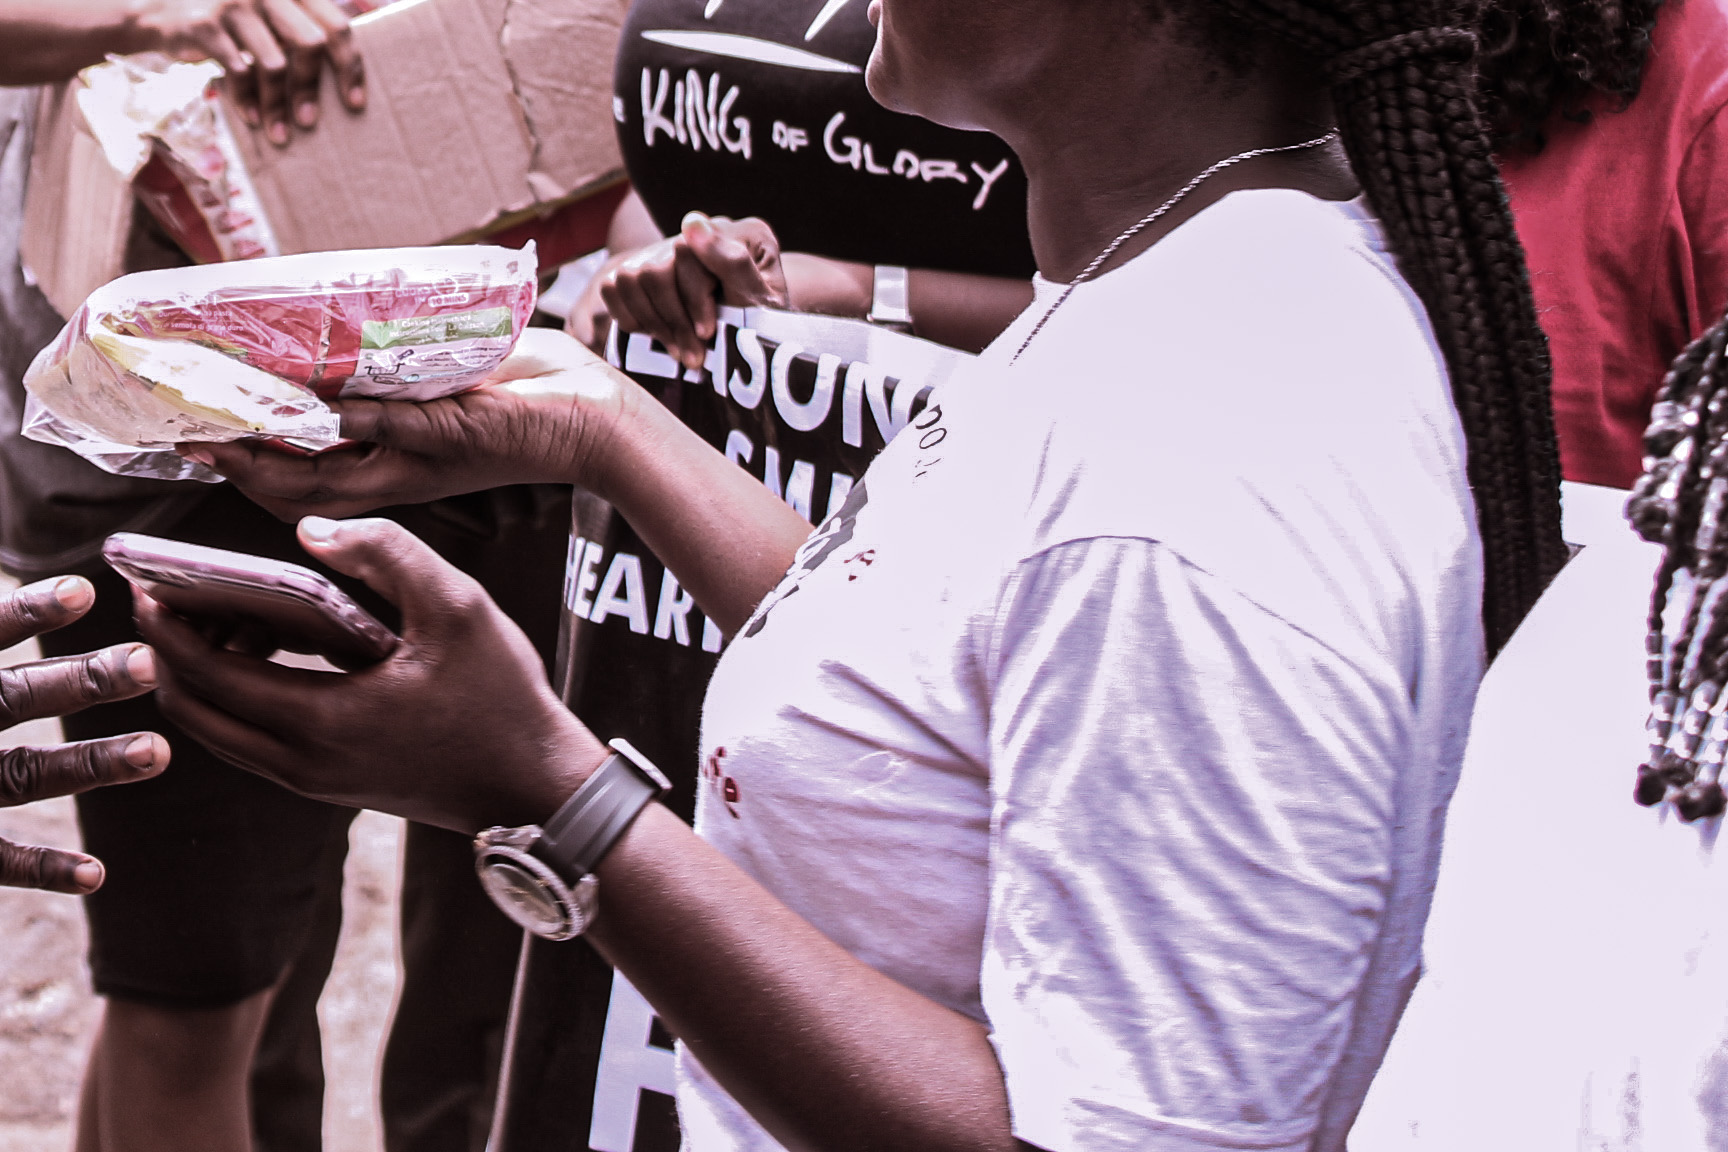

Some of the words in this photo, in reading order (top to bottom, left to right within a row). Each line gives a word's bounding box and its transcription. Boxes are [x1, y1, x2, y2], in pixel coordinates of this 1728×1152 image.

[640, 67, 752, 161] KING
[772, 120, 809, 152] OF
[823, 112, 1009, 210] GLORY
